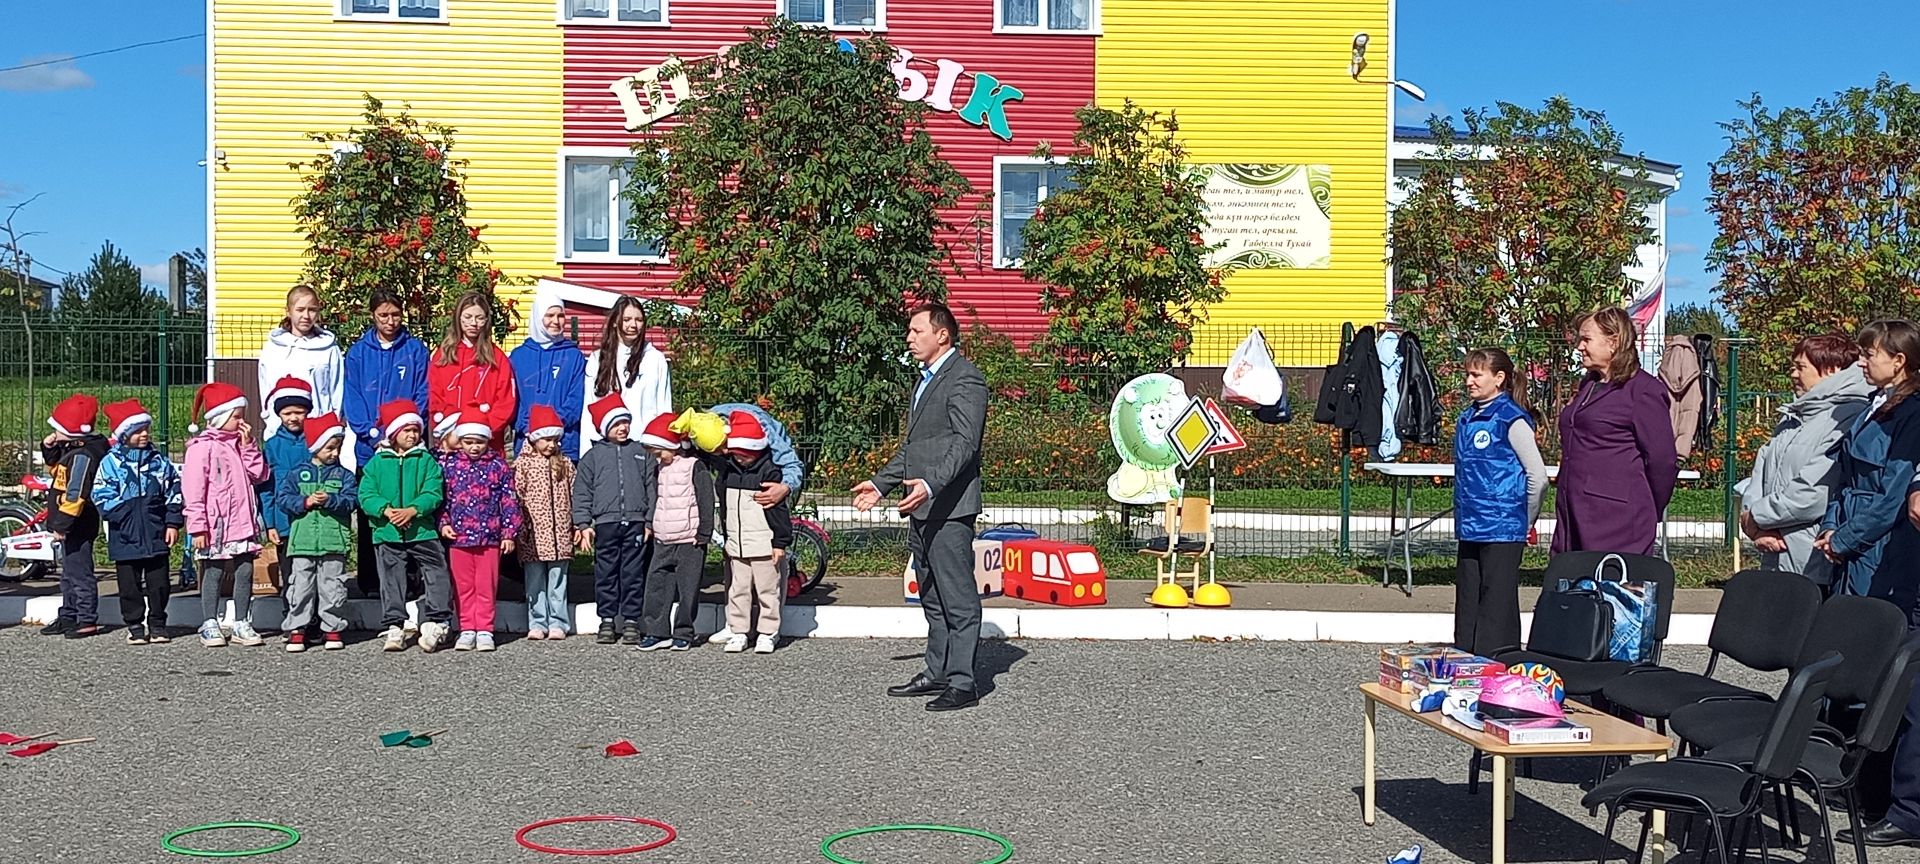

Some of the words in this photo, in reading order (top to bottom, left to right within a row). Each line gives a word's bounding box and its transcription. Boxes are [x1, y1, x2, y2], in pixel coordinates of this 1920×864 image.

[609, 37, 1024, 142] ШЫК
[1286, 239, 1312, 250] Тукай
[984, 548, 1001, 572] 02
[1005, 548, 1023, 573] 01
